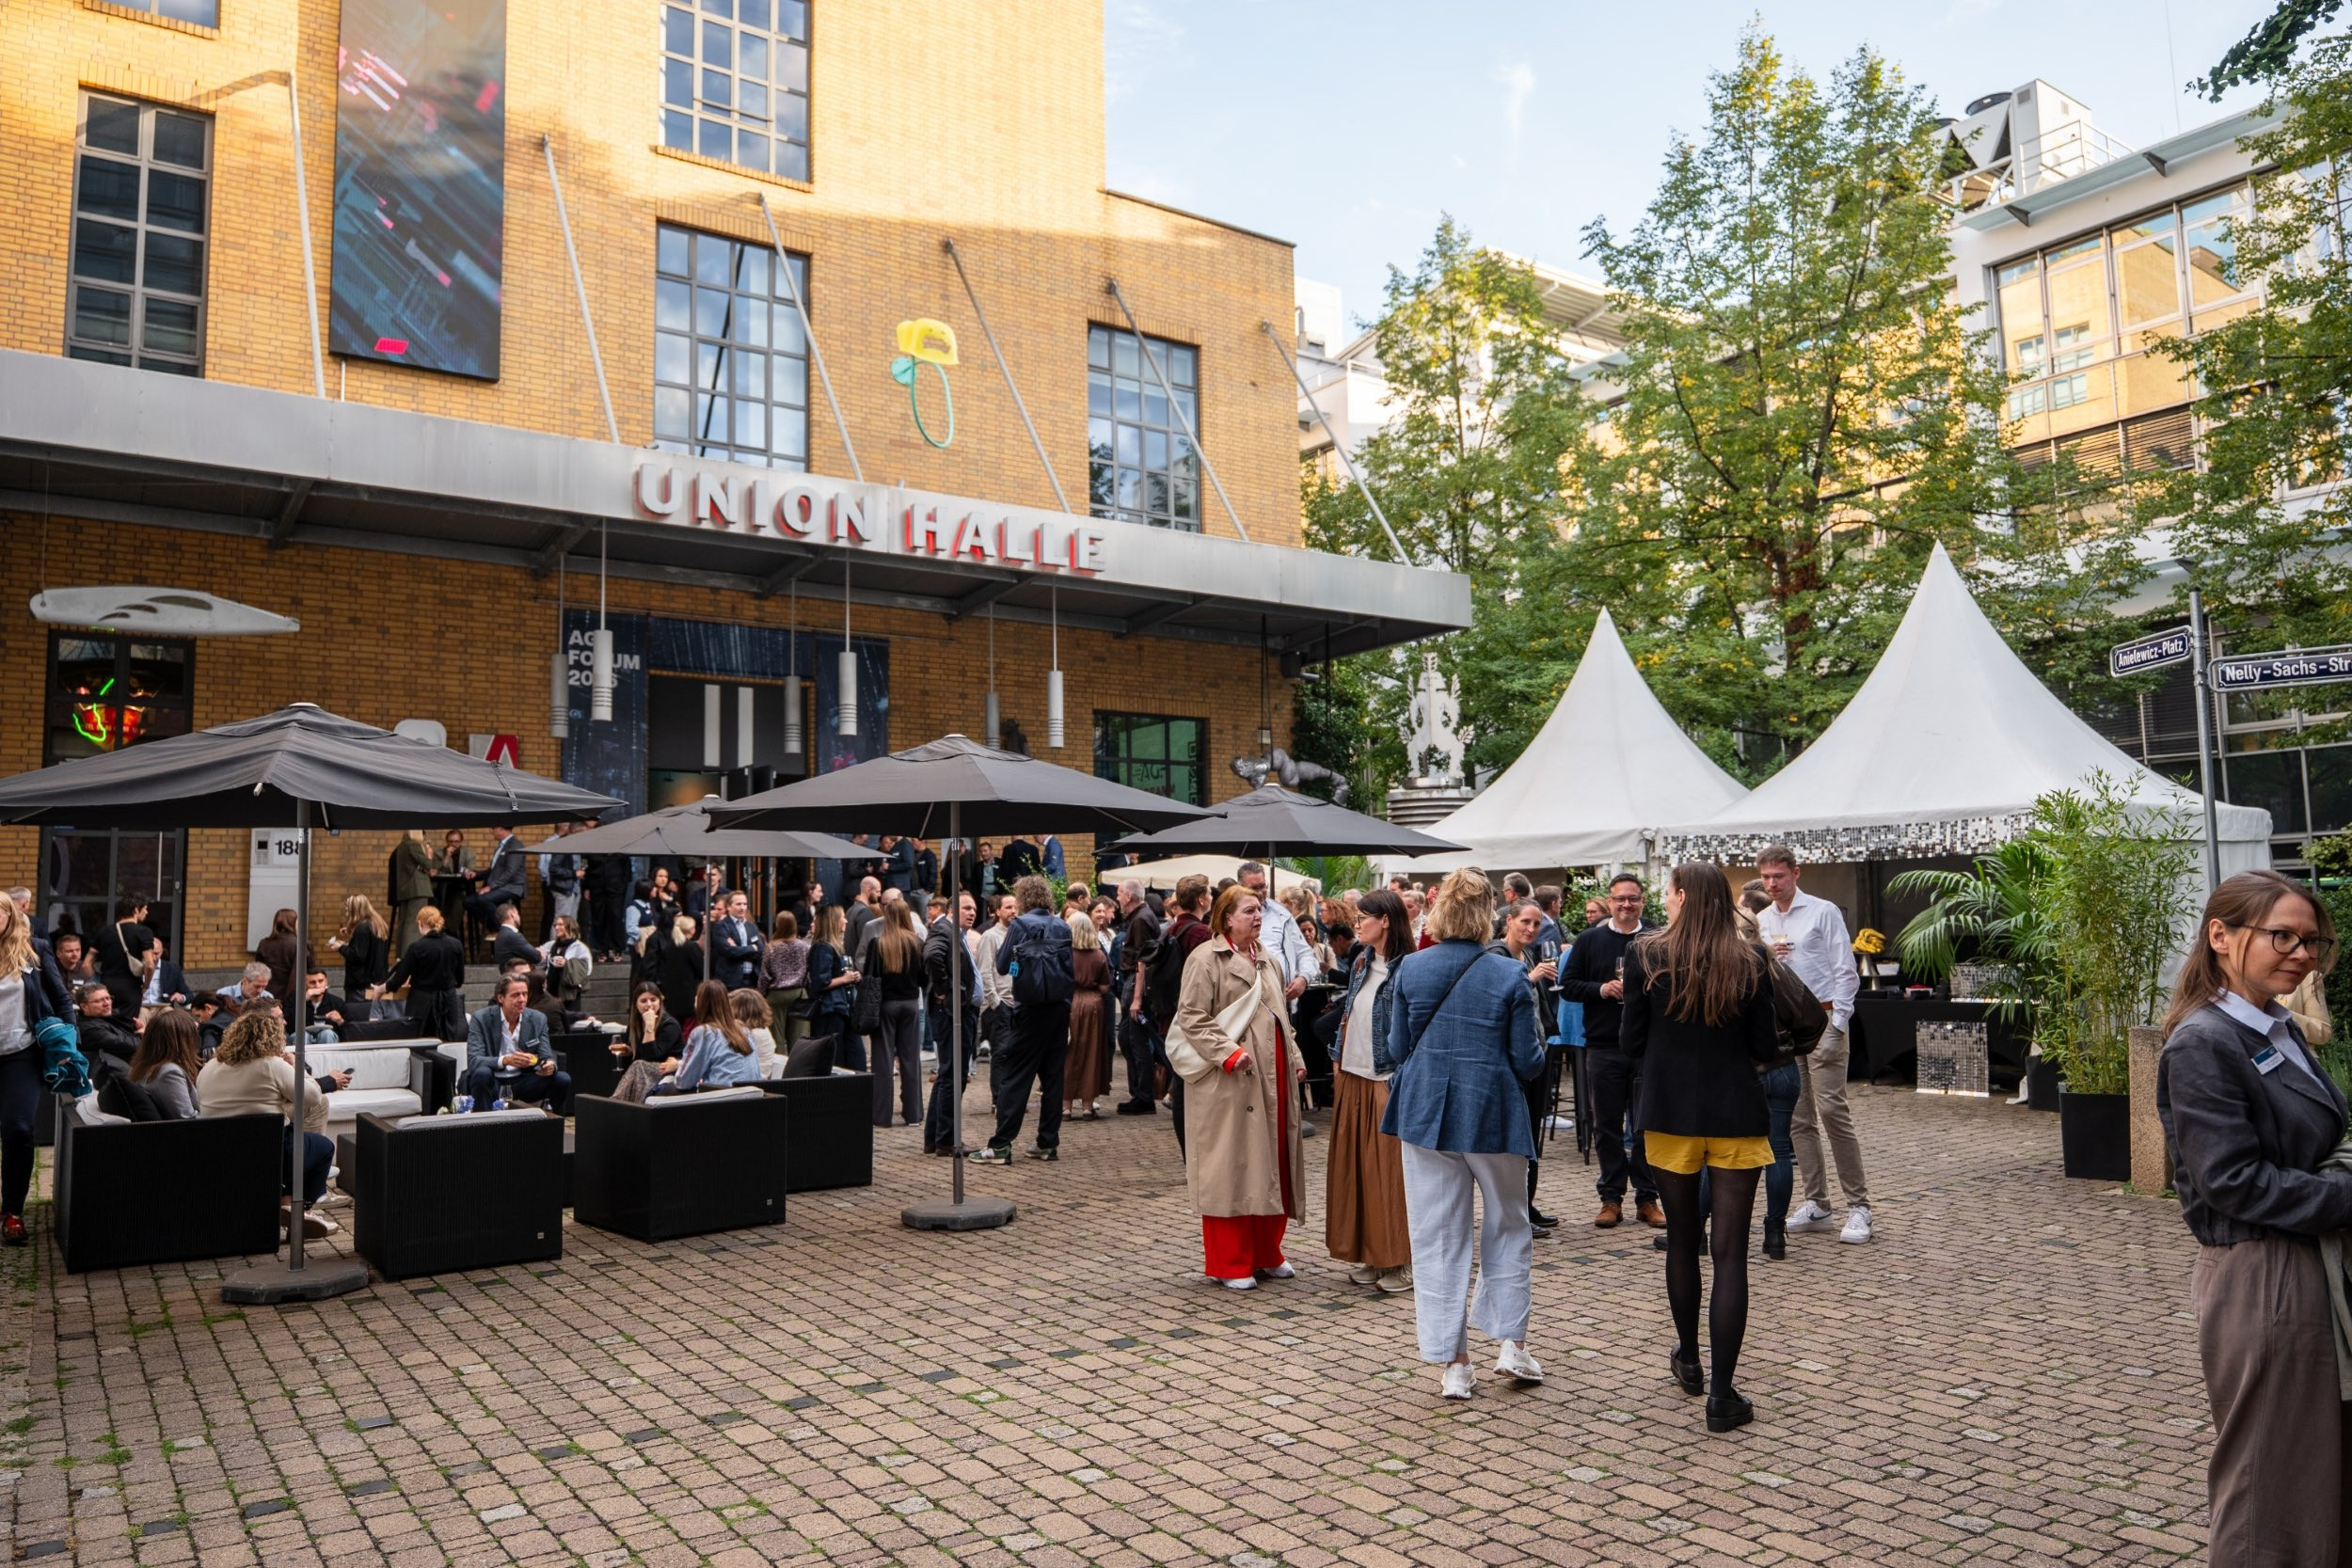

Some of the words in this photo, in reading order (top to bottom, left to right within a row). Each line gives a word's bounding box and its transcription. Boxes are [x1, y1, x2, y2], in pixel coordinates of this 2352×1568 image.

[634, 463, 874, 544] UNION
[906, 503, 1105, 575] HALLE
[568, 649, 641, 670] FOUM
[2119, 640, 2184, 668] Anielewicz-Platz
